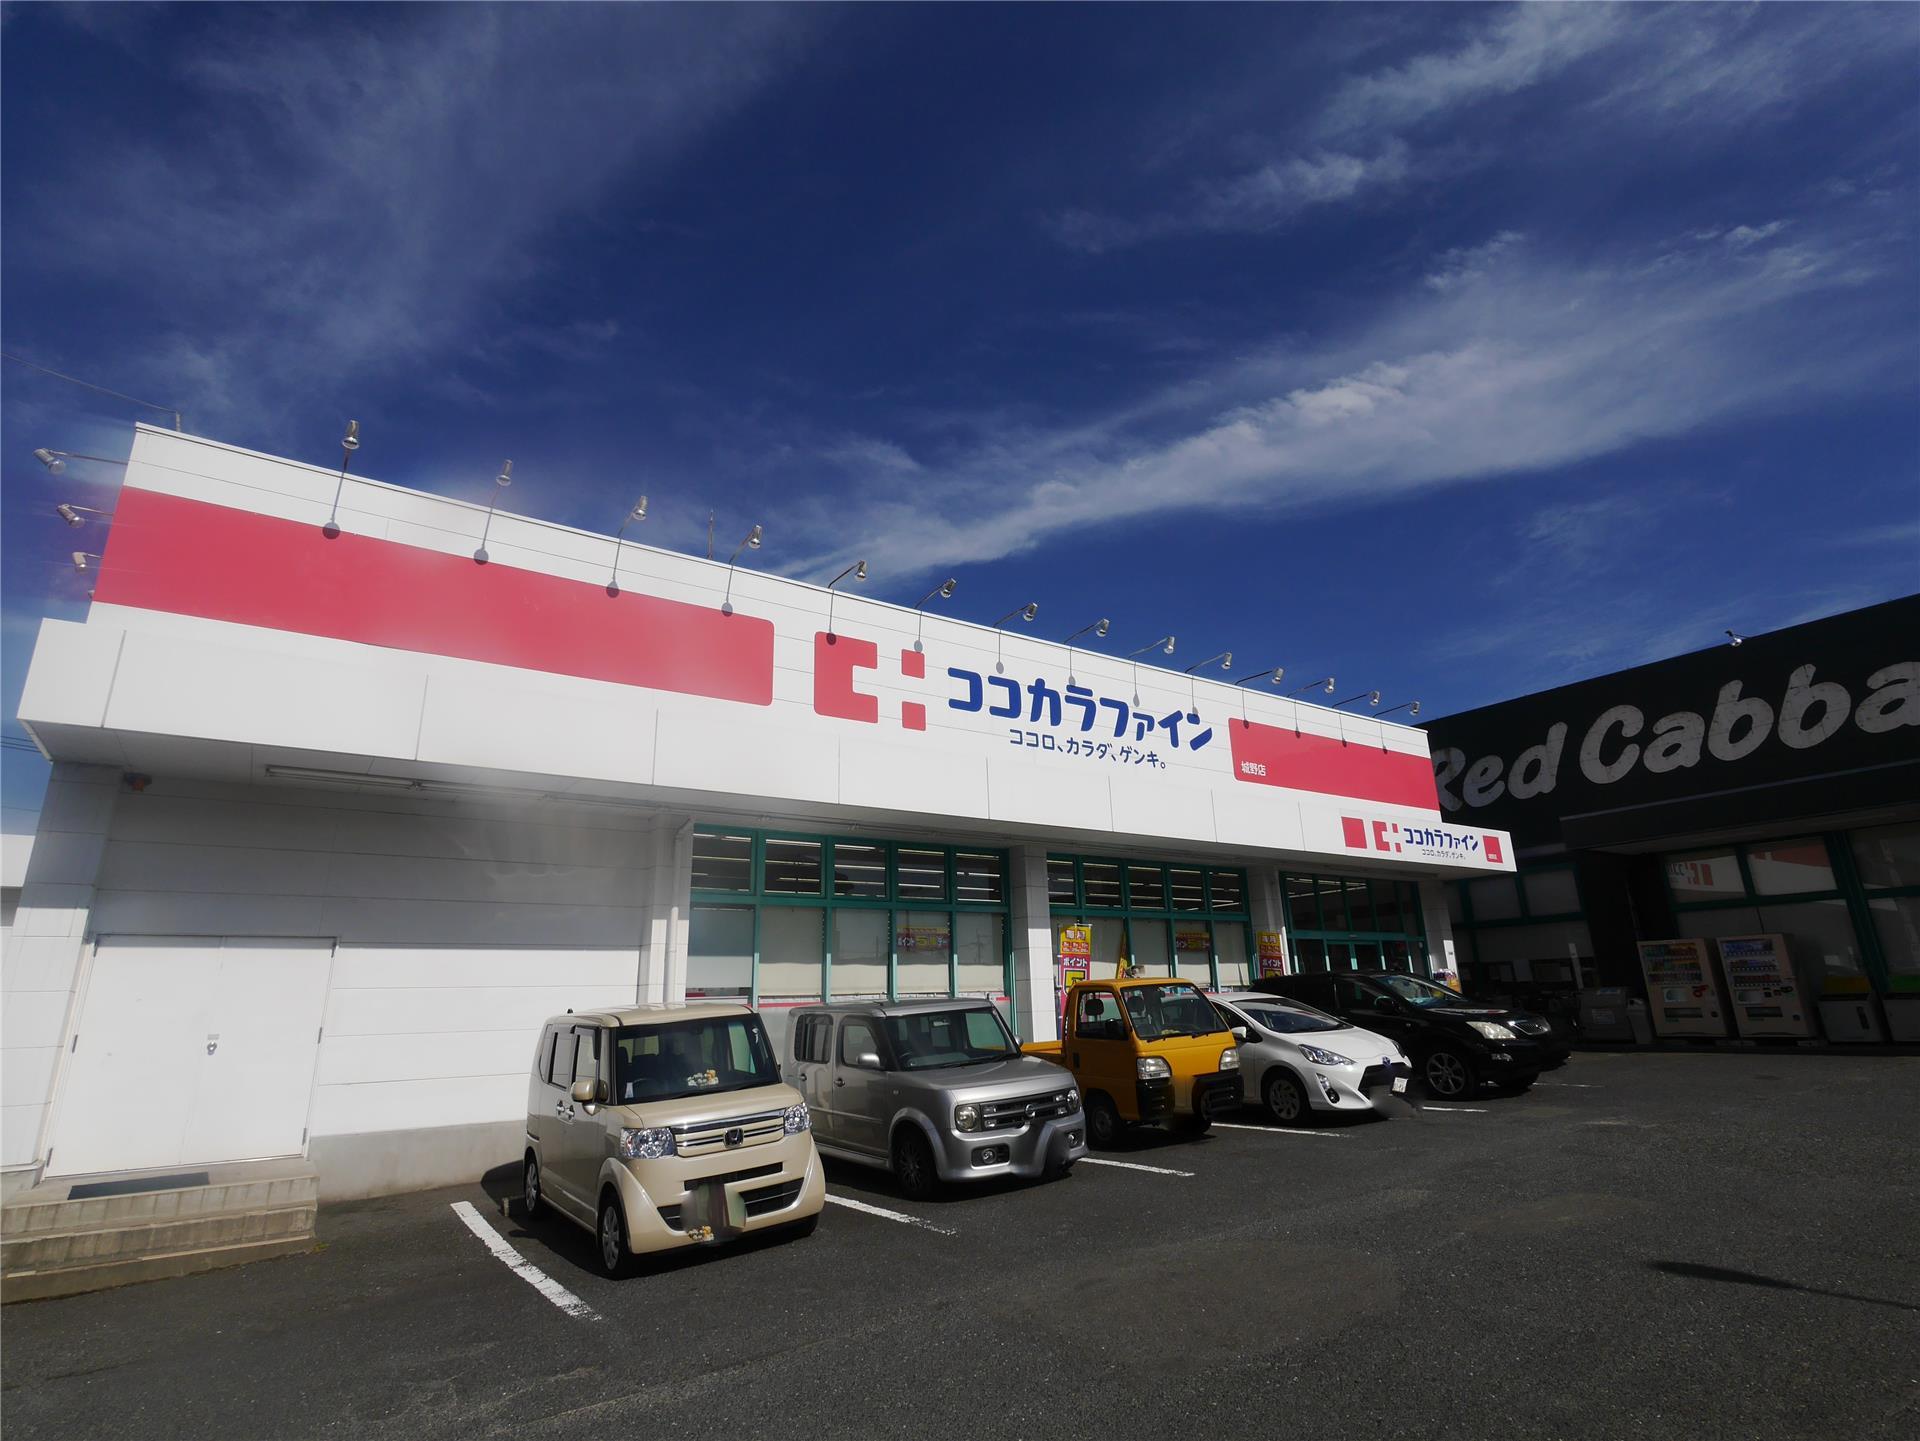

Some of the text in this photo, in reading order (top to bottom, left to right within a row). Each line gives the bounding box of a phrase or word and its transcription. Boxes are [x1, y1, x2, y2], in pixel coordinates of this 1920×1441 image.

[947, 667, 1213, 752] ココカラファイン
[1009, 728, 1166, 770] ココロ、カラダ、ゲンキ。
[1241, 760, 1267, 777] 城野店
[1432, 720, 1568, 812] Red
[1403, 827, 1479, 852] ココカラファイン
[1063, 956, 1087, 967] ポイント
